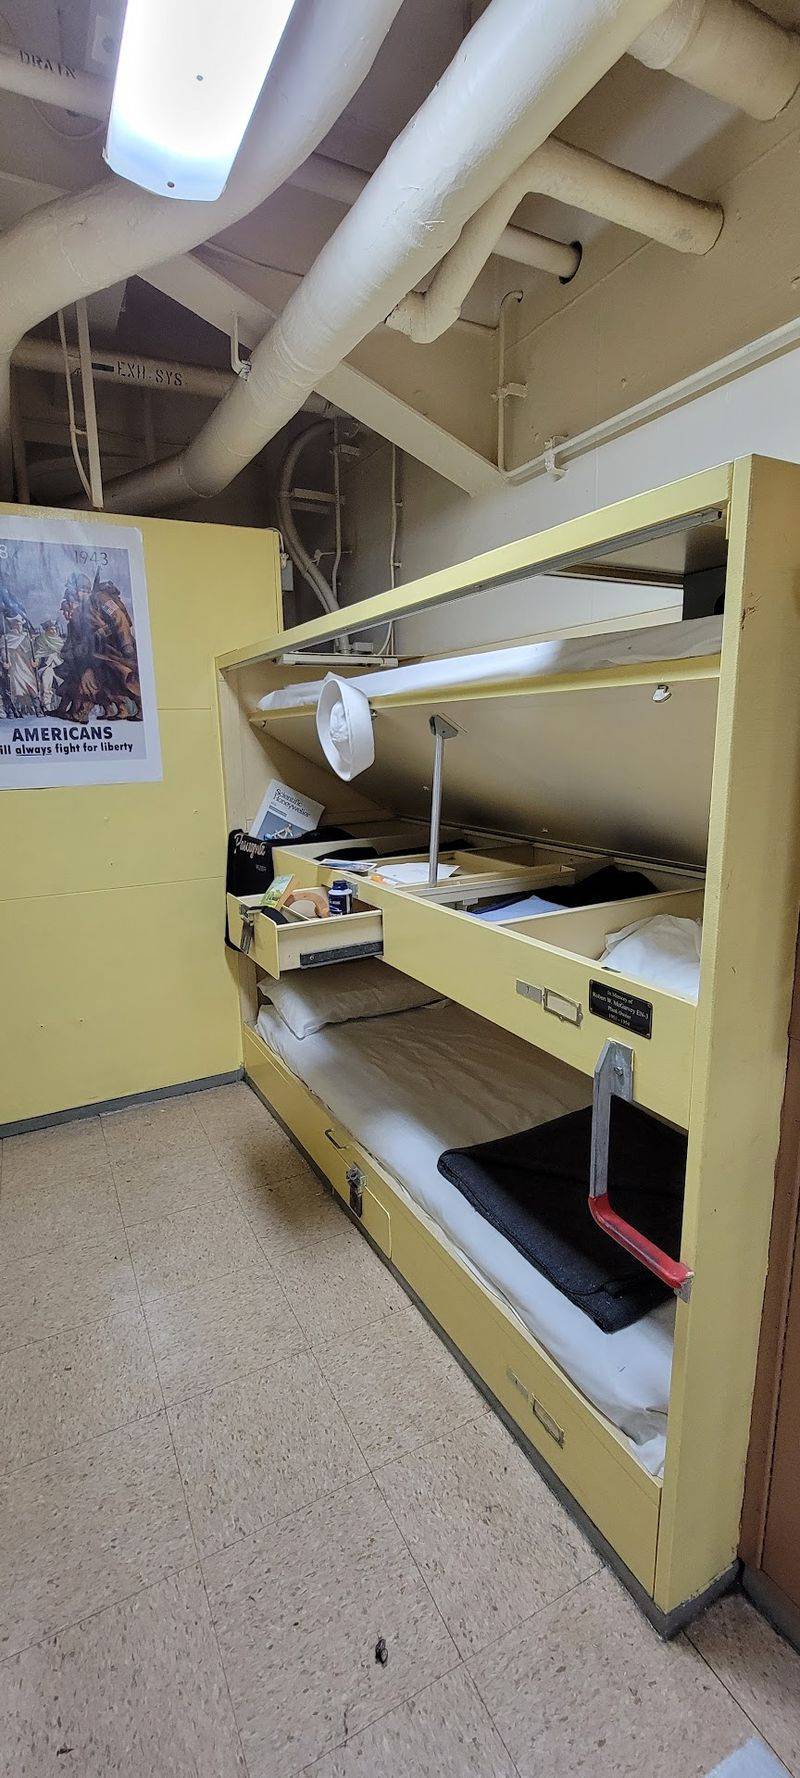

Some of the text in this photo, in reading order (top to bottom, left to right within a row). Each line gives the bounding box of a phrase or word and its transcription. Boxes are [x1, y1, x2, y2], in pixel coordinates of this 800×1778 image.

[19, 50, 76, 79] DRAIN
[155, 370, 183, 386] SYS
[74, 550, 109, 566] 1943
[12, 726, 113, 742] AMERICANS
[0, 742, 133, 756] ill always fight for liberty
